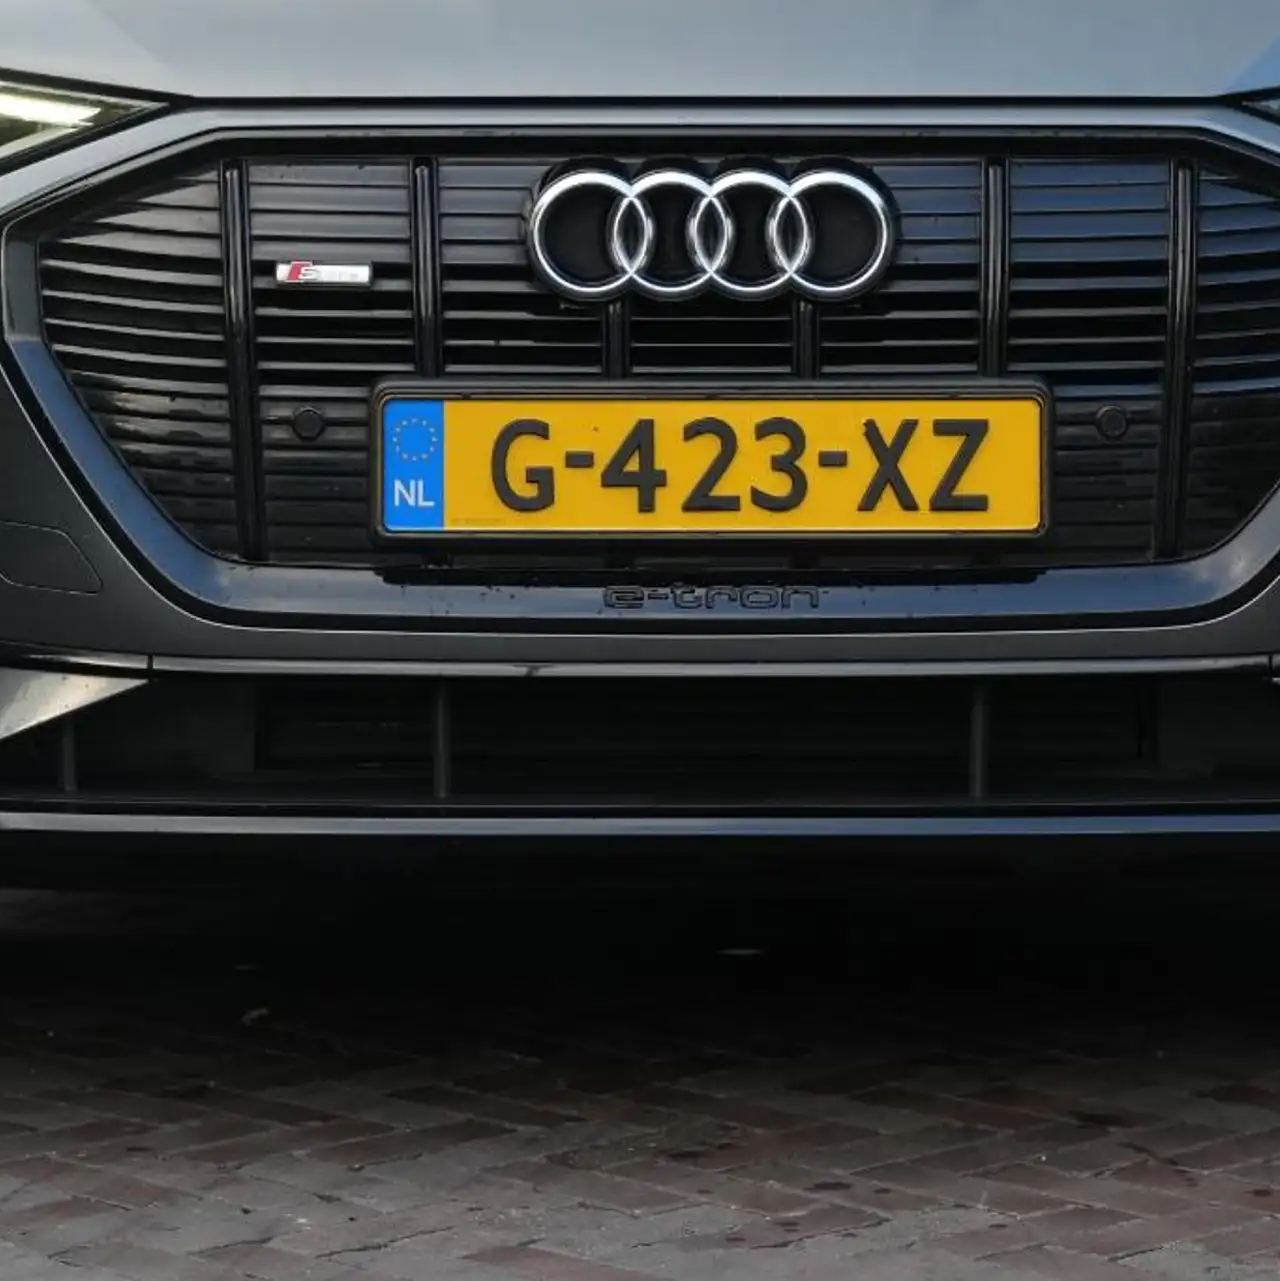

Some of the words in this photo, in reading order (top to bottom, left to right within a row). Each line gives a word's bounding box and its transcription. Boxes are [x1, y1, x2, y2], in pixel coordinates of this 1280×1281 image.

[490, 417, 990, 513] G-423-XZ
[393, 480, 434, 507] NL
[602, 583, 820, 610] e-tron
